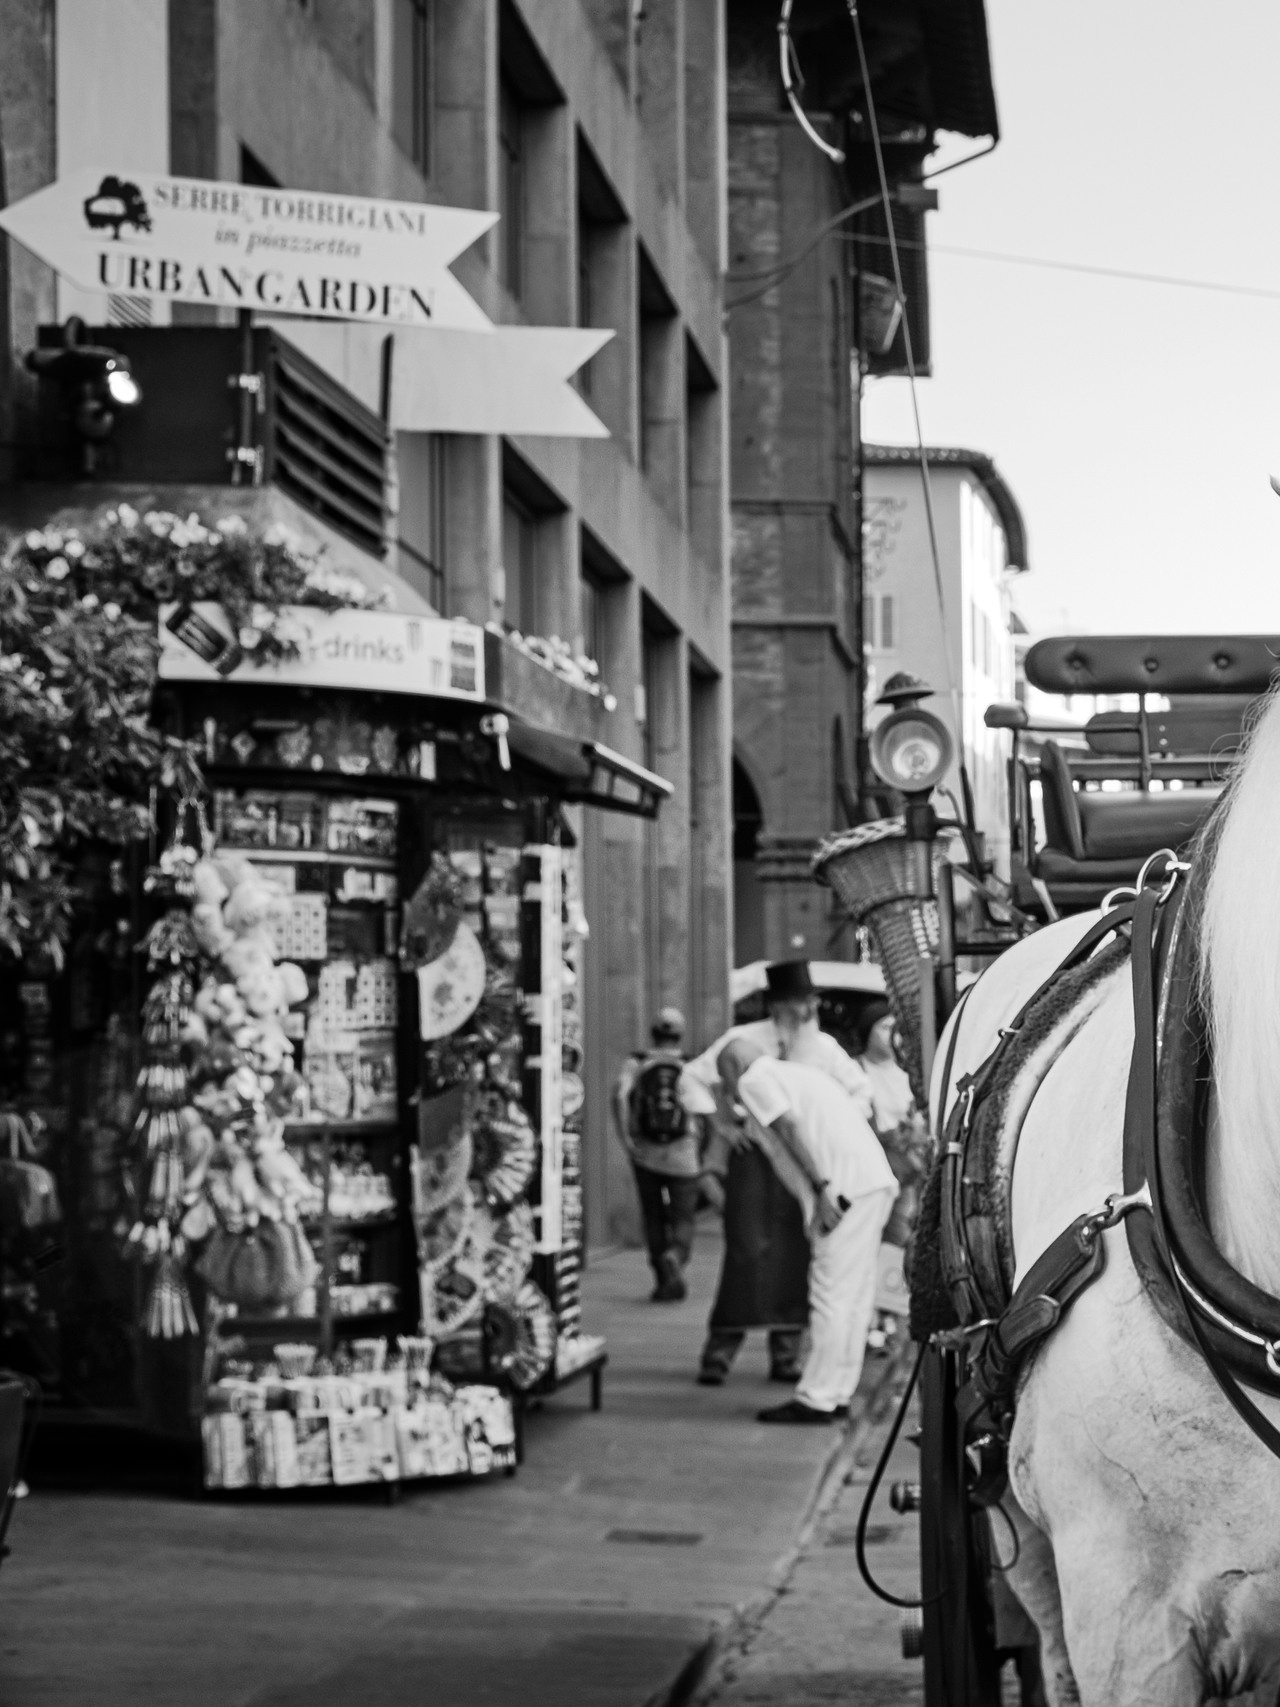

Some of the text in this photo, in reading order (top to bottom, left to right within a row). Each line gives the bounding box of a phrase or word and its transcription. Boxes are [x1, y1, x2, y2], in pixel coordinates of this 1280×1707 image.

[154, 183, 427, 236] SERRE TORRIGIANI
[214, 218, 362, 259] in piazzetta
[323, 633, 405, 665] drinks
